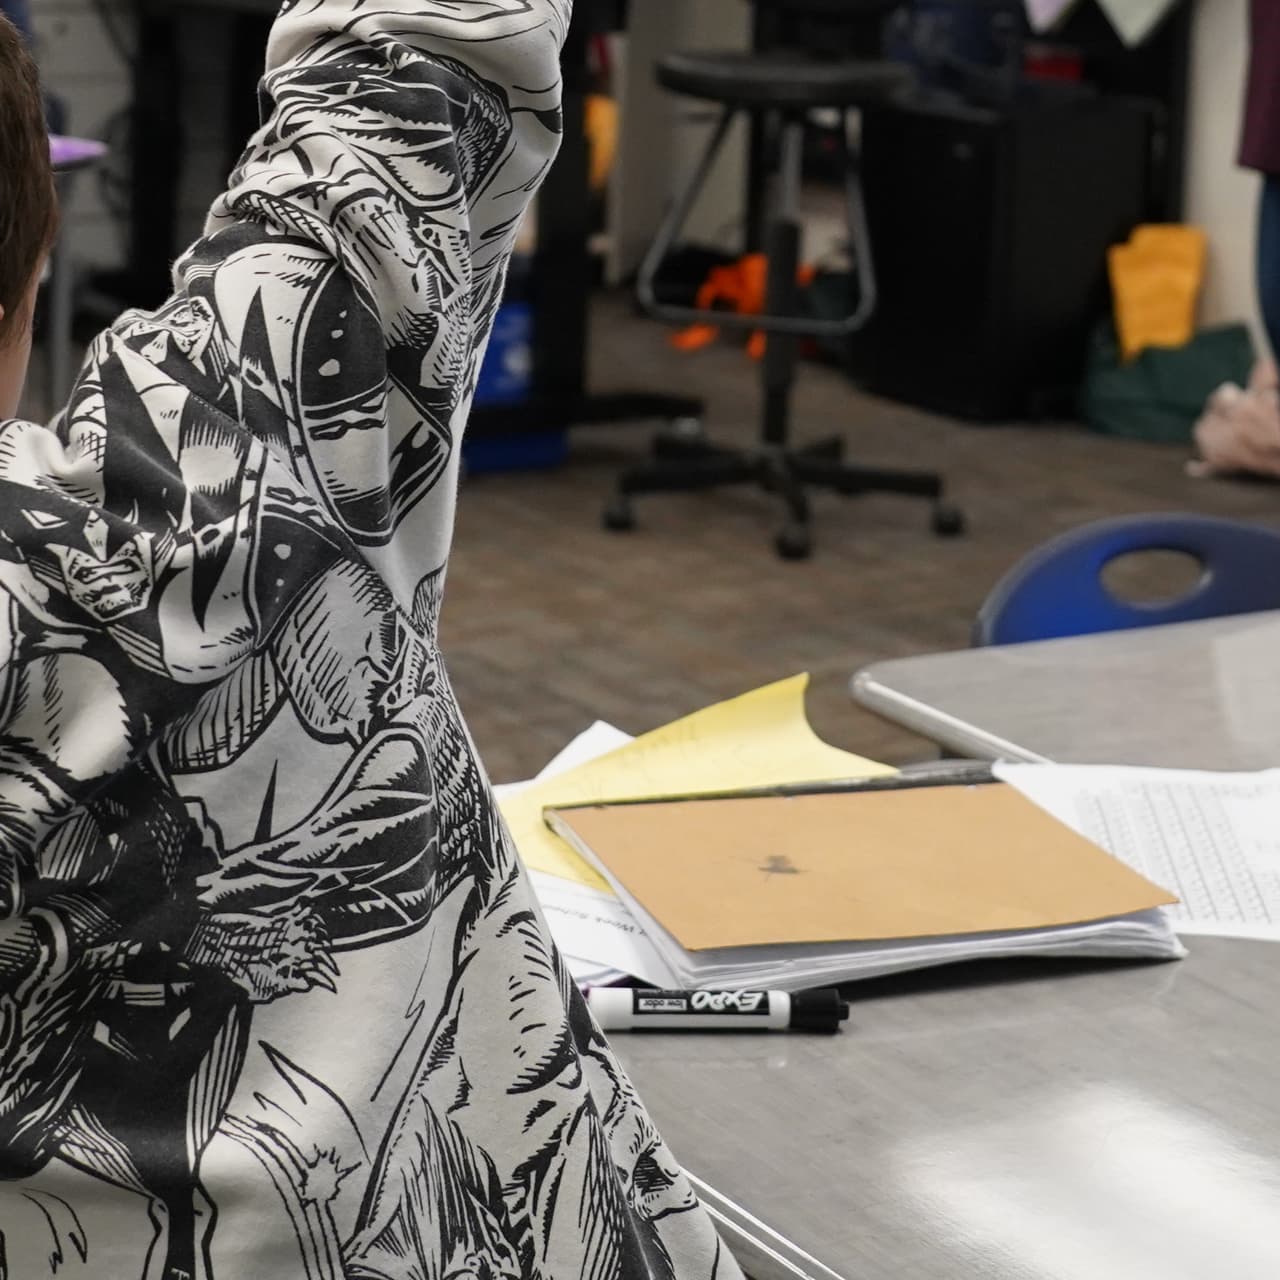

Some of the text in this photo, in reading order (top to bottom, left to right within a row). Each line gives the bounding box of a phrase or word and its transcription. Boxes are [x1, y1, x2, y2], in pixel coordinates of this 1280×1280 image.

[643, 989, 763, 1012] EXPO low odor
